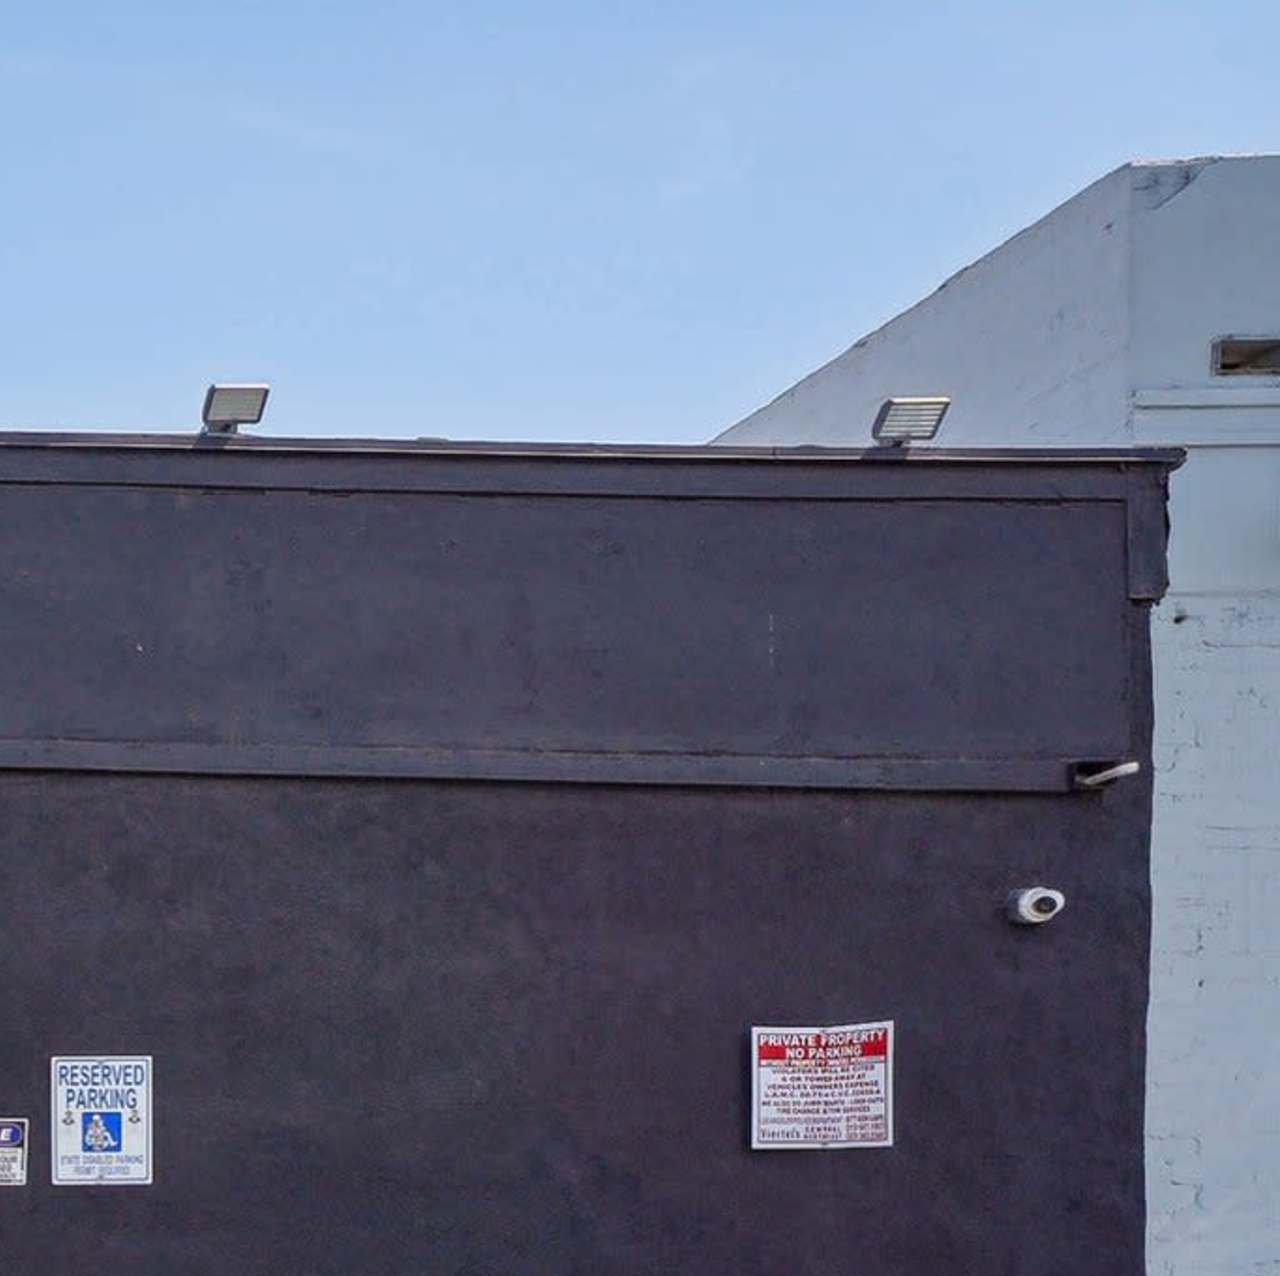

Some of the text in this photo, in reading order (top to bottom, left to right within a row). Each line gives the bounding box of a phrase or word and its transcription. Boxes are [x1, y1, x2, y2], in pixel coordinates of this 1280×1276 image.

[759, 1030, 884, 1046] PRIVATE PROPERTY
[786, 1045, 863, 1059] NO PARKING
[58, 1064, 145, 1087] RESERVED
[65, 1087, 138, 1110] PARKING
